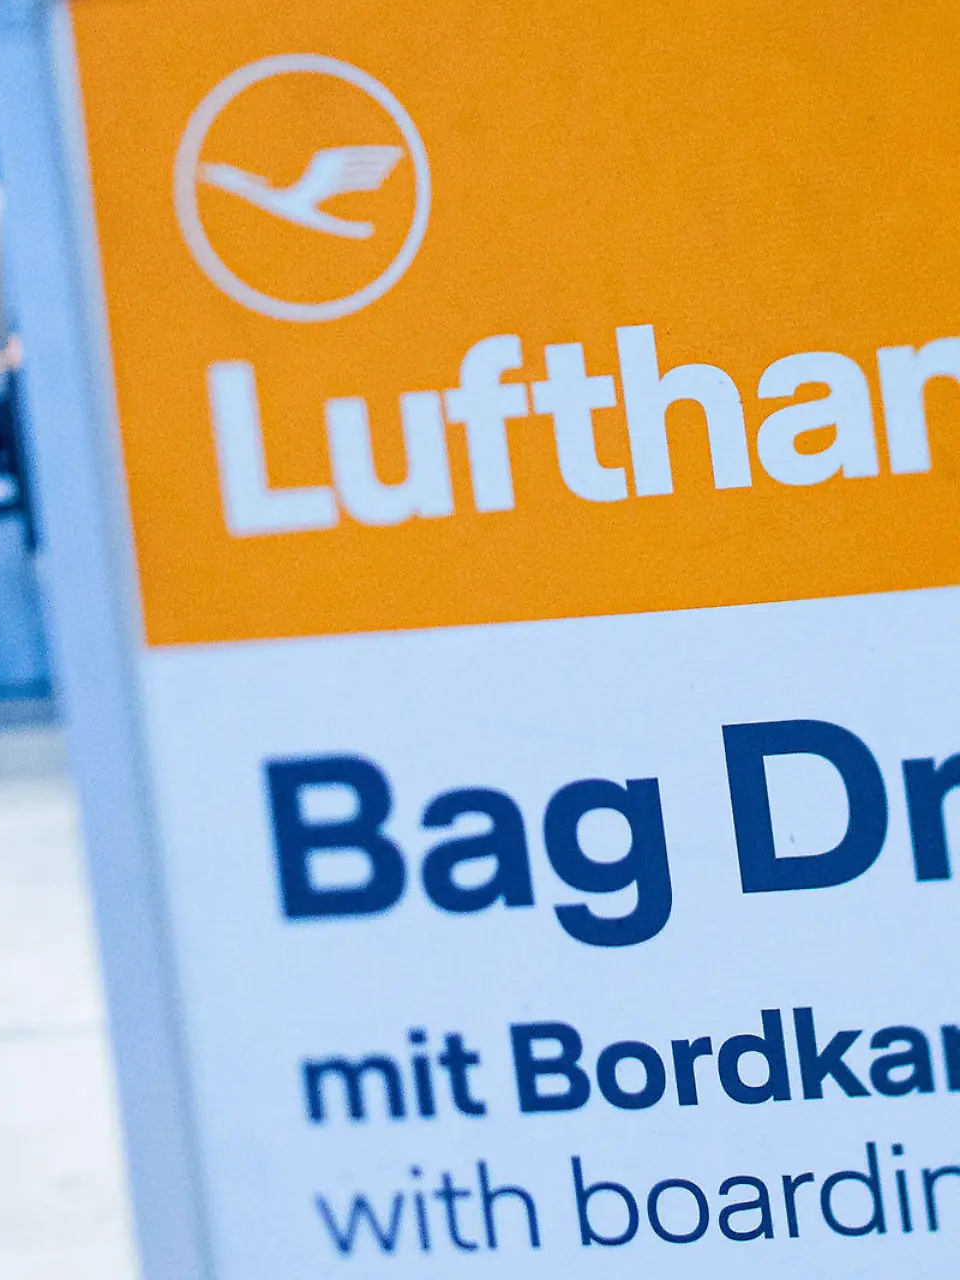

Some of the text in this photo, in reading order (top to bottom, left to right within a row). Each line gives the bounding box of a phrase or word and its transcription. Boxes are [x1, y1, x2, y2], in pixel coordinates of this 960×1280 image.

[263, 718, 960, 948] Bag Dr
[303, 1025, 487, 1124] mit
[315, 1158, 541, 1258] with
